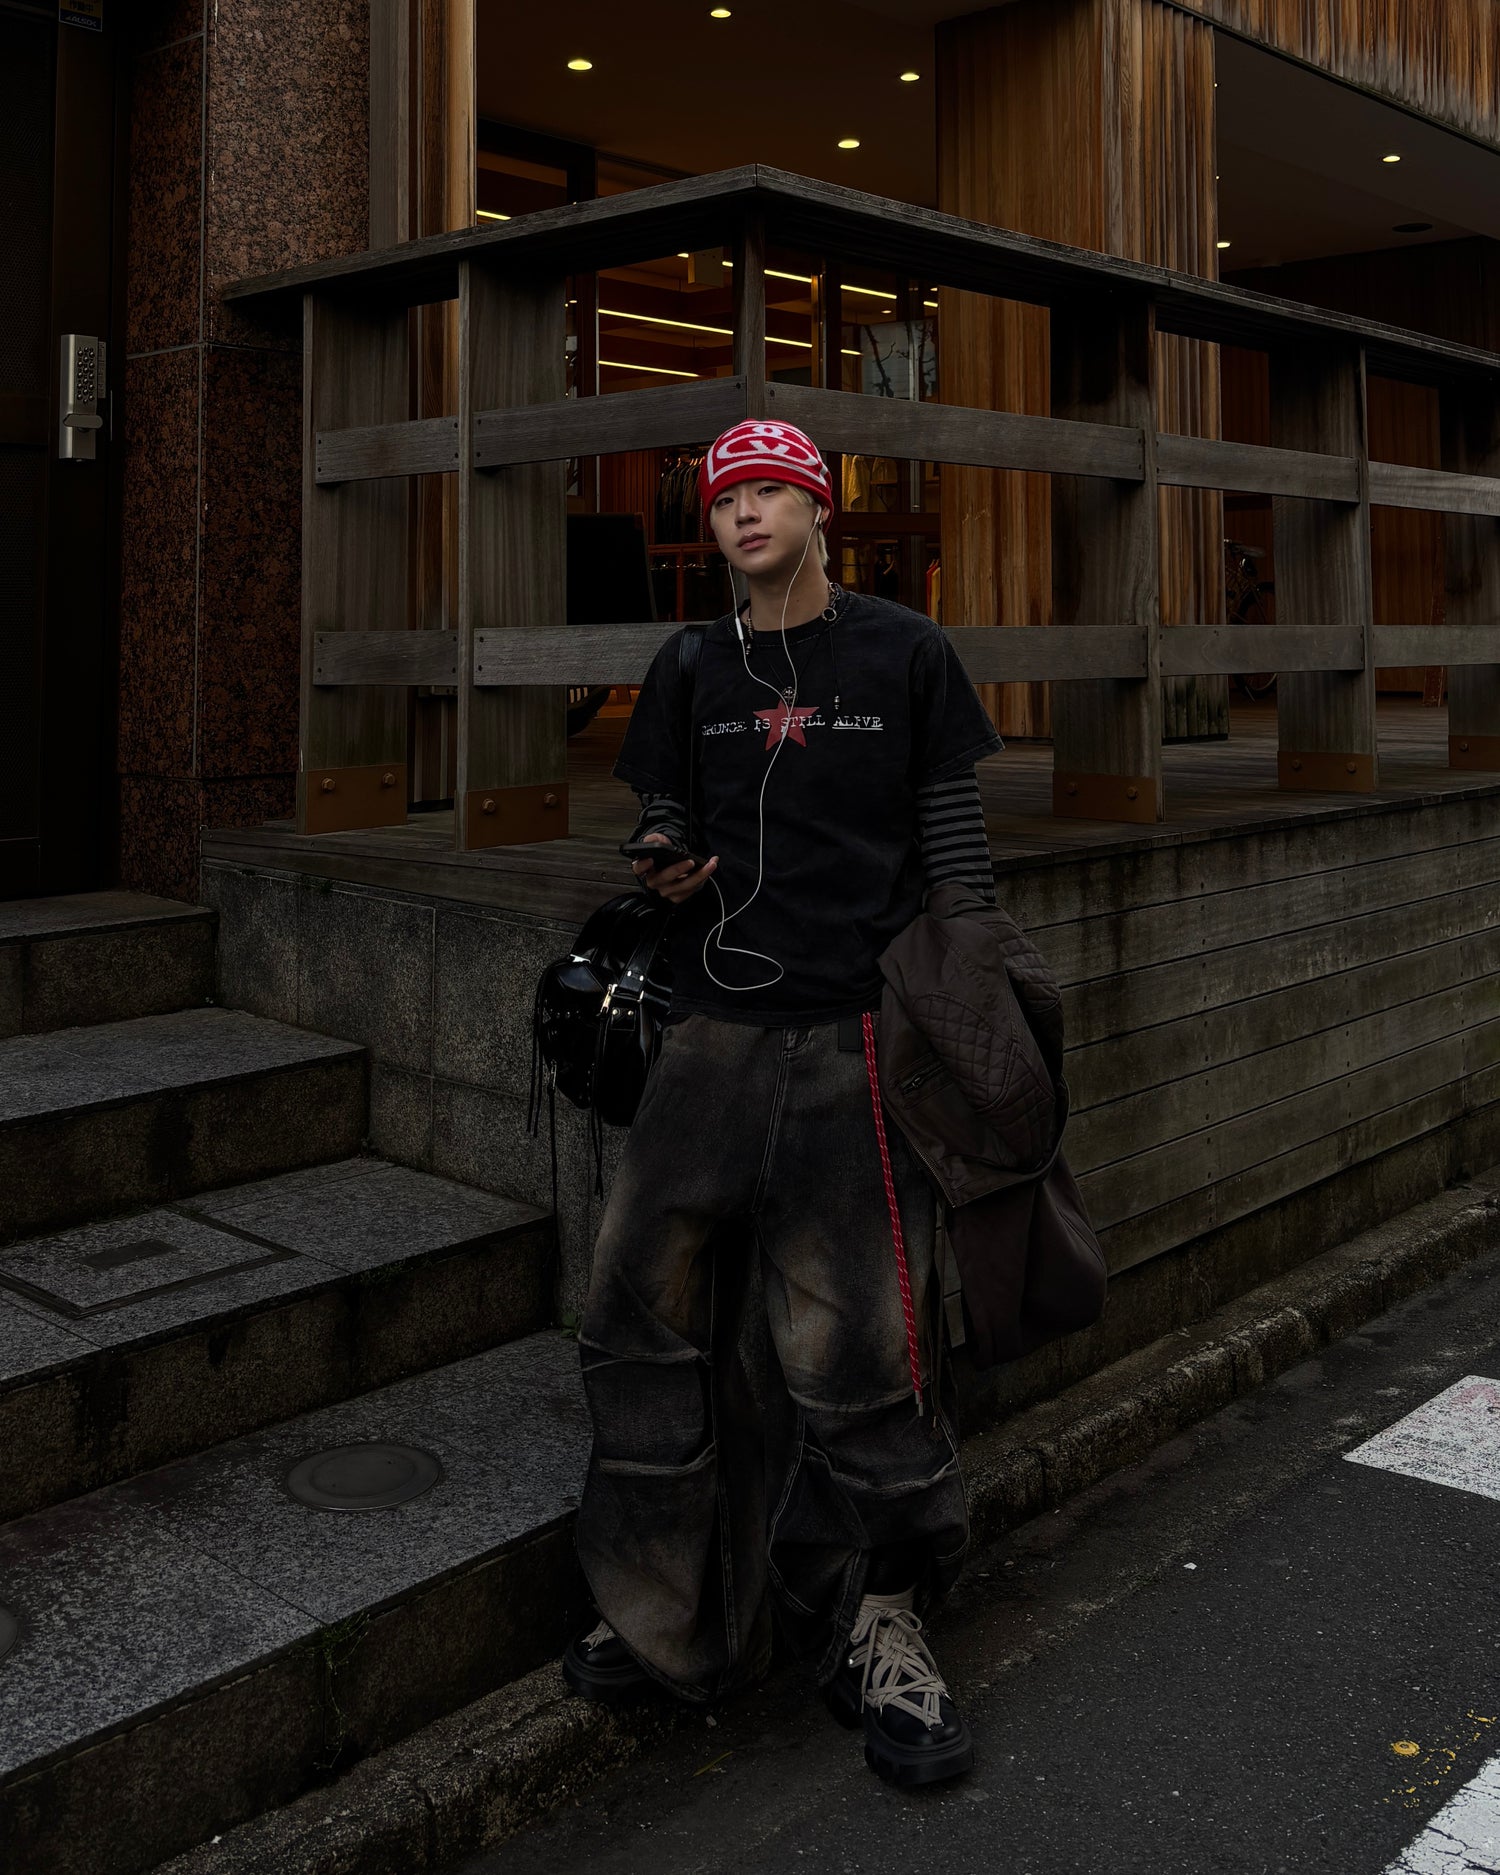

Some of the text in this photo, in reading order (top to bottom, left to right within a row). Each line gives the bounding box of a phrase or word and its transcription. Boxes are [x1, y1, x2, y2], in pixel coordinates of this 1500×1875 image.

[754, 718, 771, 732] IS
[780, 715, 826, 729] STILL
[832, 715, 884, 730] ALIVE
